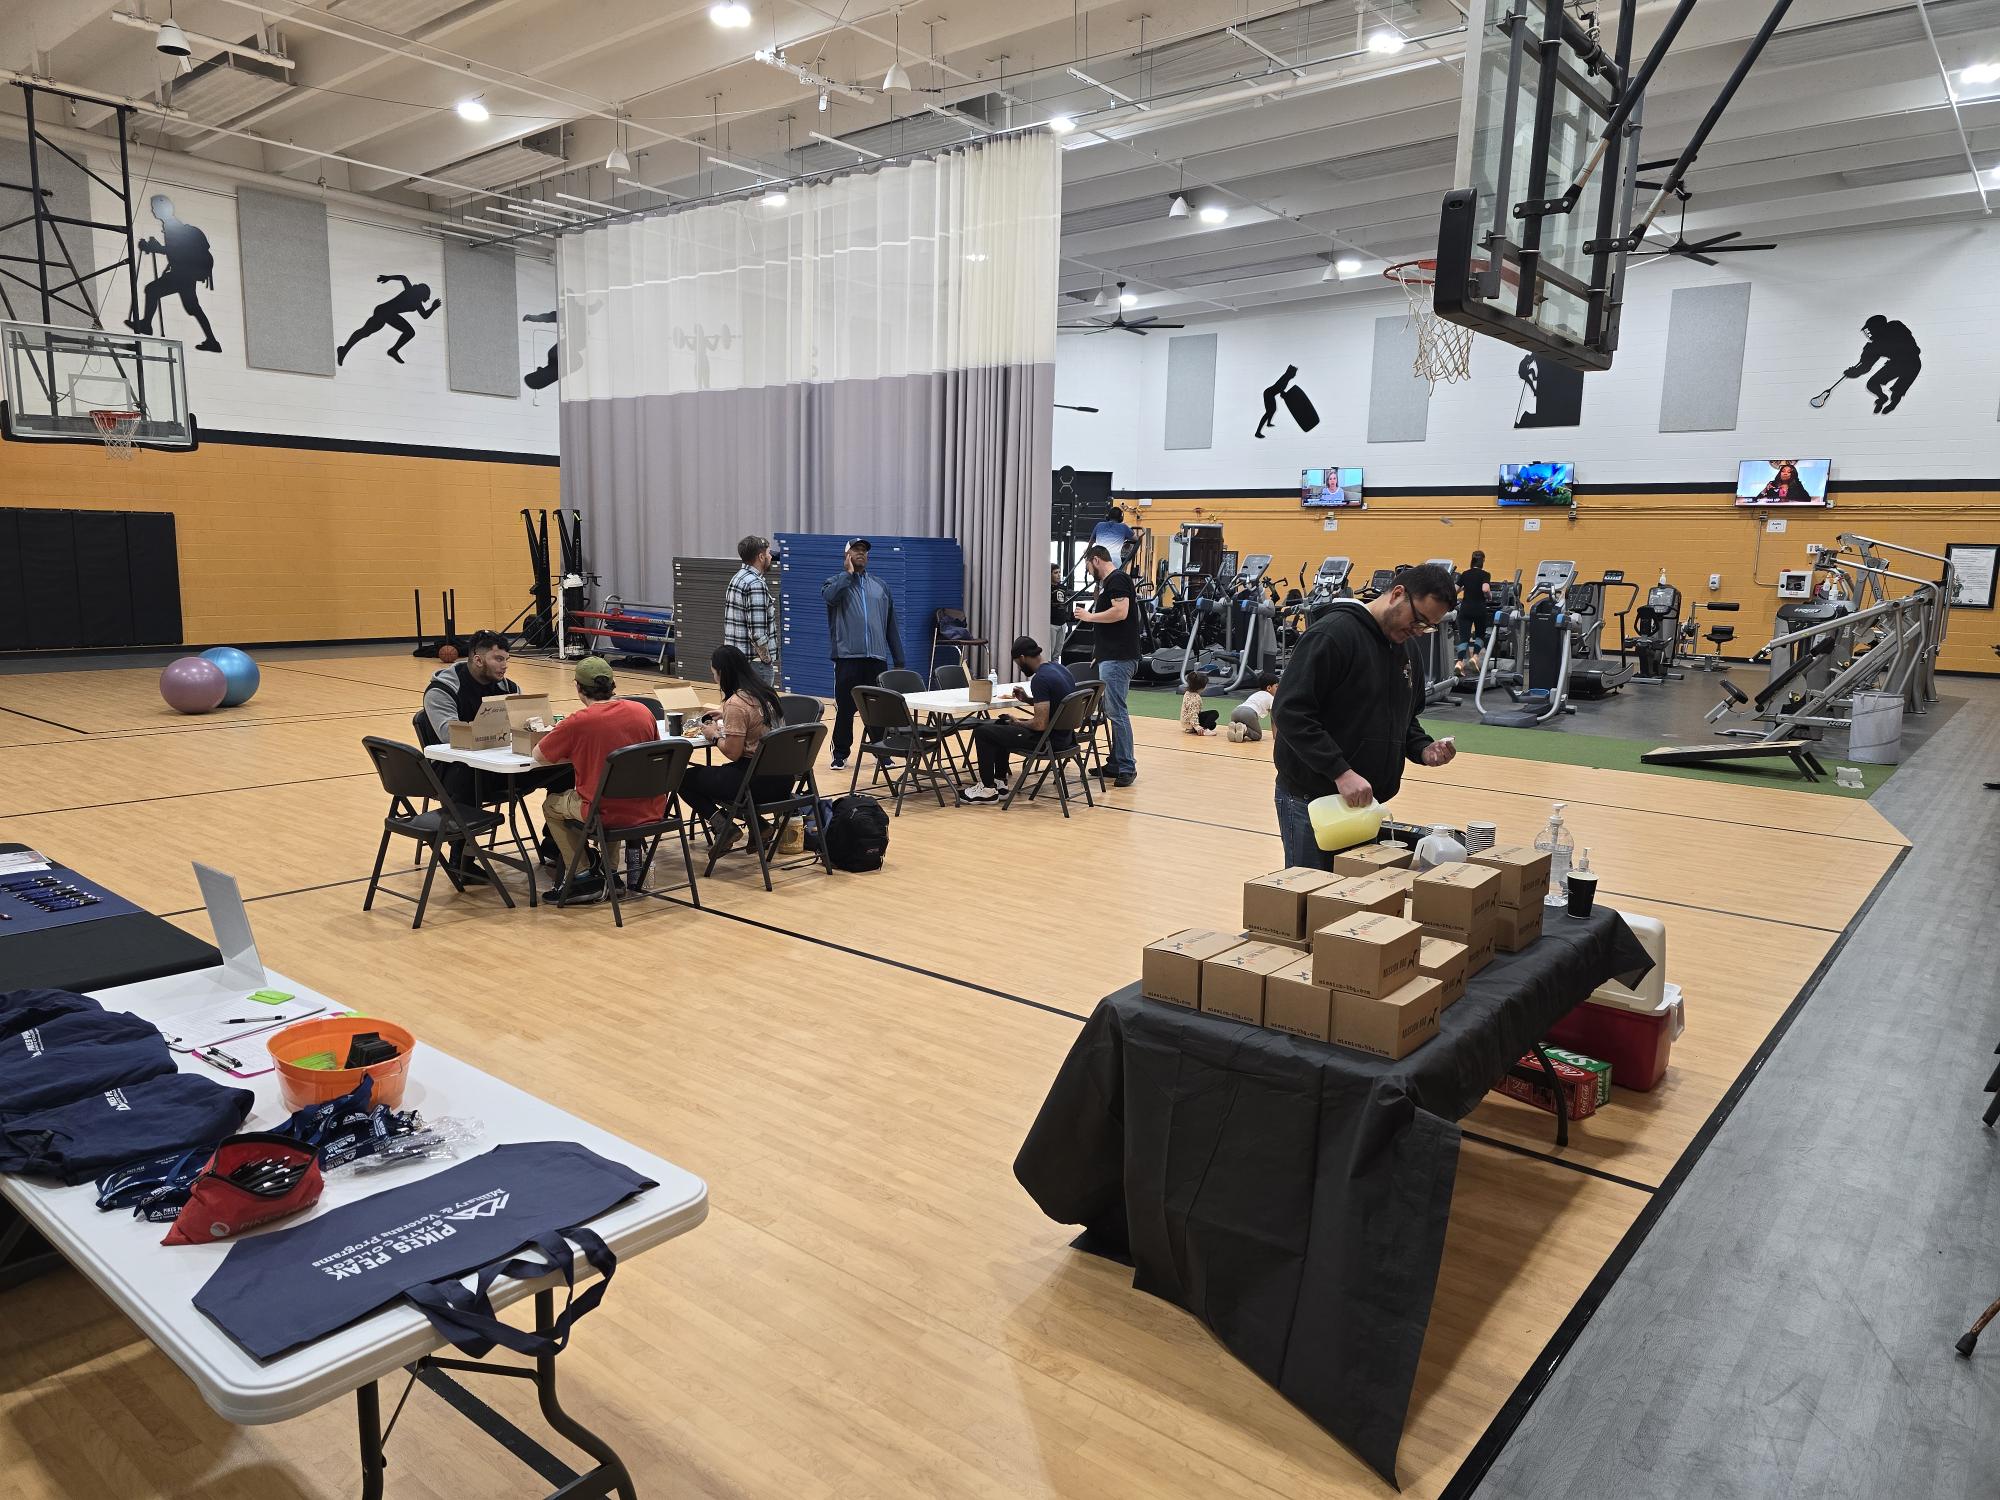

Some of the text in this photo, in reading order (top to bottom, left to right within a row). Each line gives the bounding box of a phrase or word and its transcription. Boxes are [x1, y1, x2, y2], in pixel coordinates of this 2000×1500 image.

[310, 1188, 506, 1269] Military & Veterans Programs
[321, 1219, 444, 1273] STATE COLLEGE
[327, 1222, 457, 1281] PIKES PEAK
